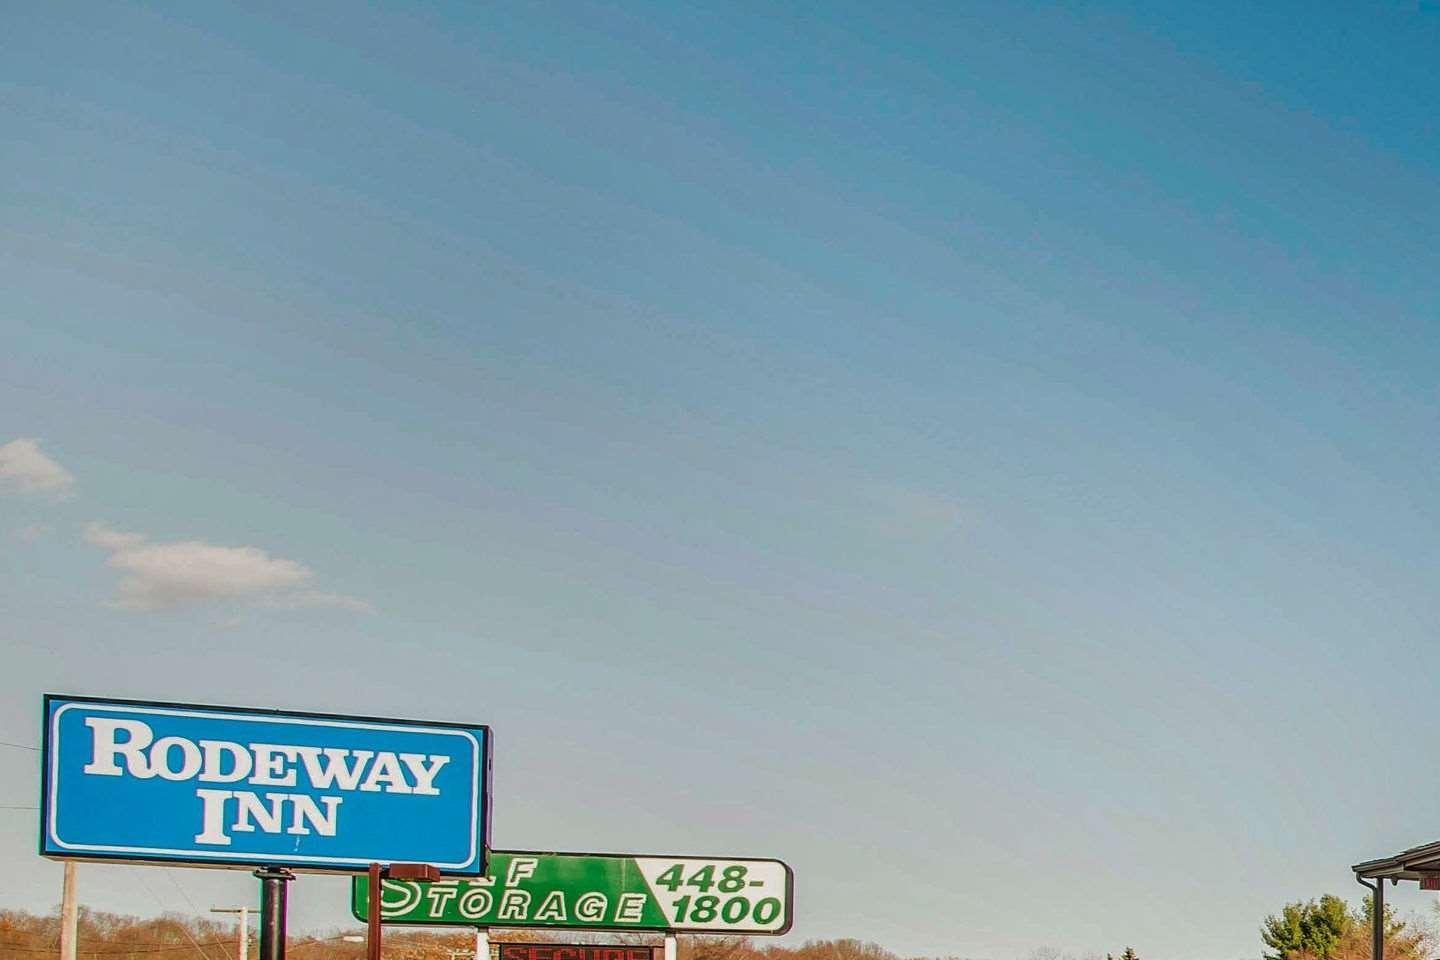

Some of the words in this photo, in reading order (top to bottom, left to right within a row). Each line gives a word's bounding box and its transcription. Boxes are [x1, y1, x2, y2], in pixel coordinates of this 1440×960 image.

[83, 717, 450, 796] RODEWAY
[194, 788, 343, 845] INN
[655, 863, 764, 893] 448-
[672, 895, 781, 925] 1800
